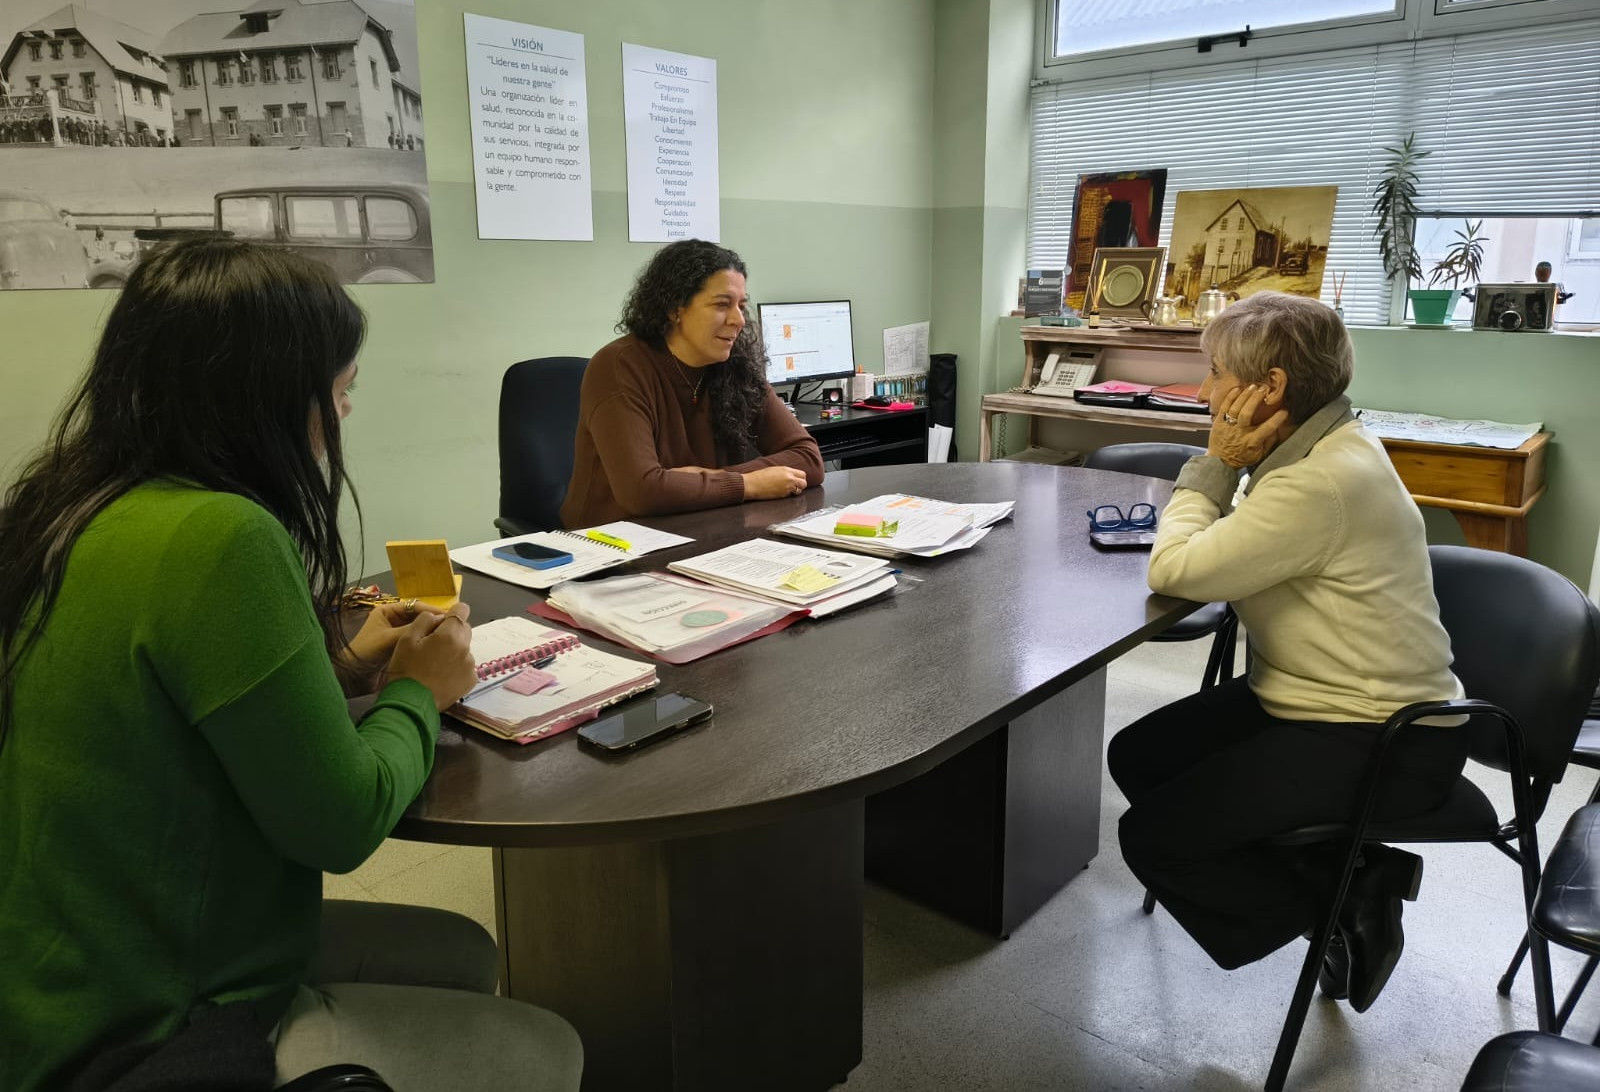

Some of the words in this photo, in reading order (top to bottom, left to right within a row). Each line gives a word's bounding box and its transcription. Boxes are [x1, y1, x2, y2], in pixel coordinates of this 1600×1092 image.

[512, 37, 544, 51] VISIÓN
[521, 62, 529, 70] en
[532, 62, 538, 71] la
[540, 65, 557, 75] salud
[560, 68, 568, 76] de
[656, 63, 688, 76] VALORES
[503, 75, 530, 85] nuestra
[533, 80, 556, 89] gente"
[654, 81, 690, 93] Compromiso
[481, 85, 496, 96] Una
[502, 90, 545, 102] organización
[506, 106, 544, 118] reconocida
[559, 113, 564, 121] la
[482, 120, 514, 130] munidad
[518, 124, 531, 132] por
[535, 124, 540, 133] la
[544, 126, 567, 136] calidad
[570, 129, 579, 137] de
[662, 126, 685, 135] Libertad
[535, 141, 565, 151] integrada
[568, 144, 580, 152] por
[659, 146, 690, 156] Experiencia
[497, 153, 522, 162] equipo
[524, 153, 553, 163] humano
[555, 158, 580, 166] respon-
[486, 166, 504, 175] sable
[507, 170, 512, 178] y
[515, 169, 566, 180] comprometido
[487, 181, 493, 190] la
